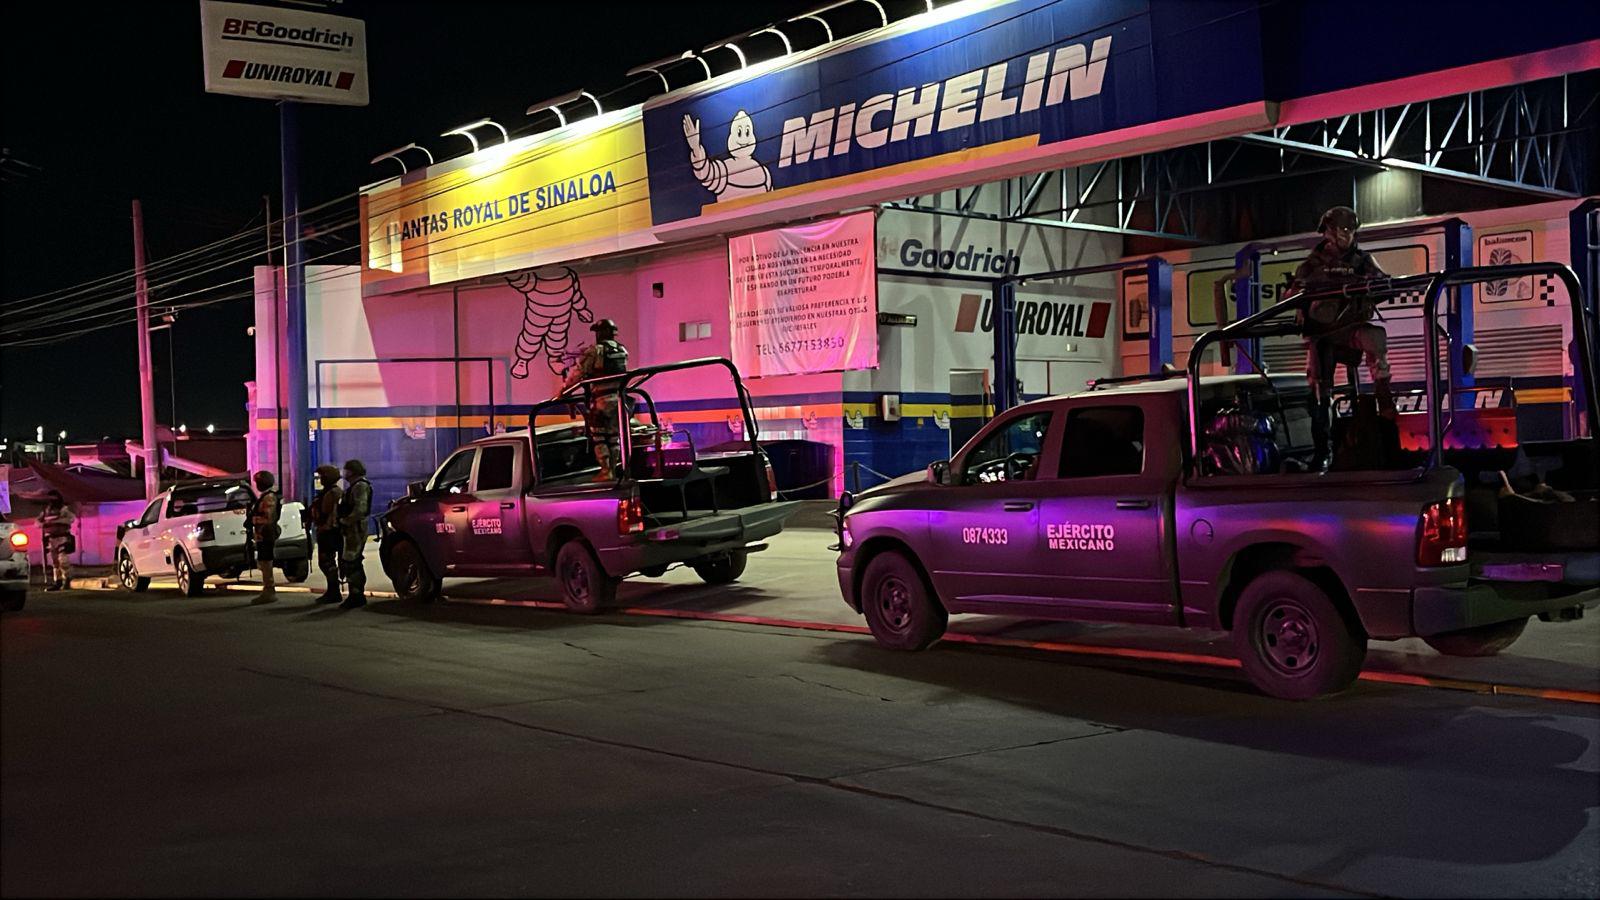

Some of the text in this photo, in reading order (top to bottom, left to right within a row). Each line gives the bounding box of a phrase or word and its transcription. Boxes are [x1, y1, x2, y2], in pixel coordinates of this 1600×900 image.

[222, 18, 353, 47] BFGoodrich
[245, 63, 333, 87] UNIROYAL
[778, 36, 1112, 168] MICHELIN
[453, 201, 503, 229] ROYAL
[508, 191, 530, 216] DE
[536, 170, 617, 210] SINALOA
[831, 238, 859, 249] NUESTRA
[767, 260, 778, 268] NOS
[818, 250, 851, 261] NECESIDAD
[798, 274, 821, 284] FUTURO
[822, 270, 850, 280] PODERLA
[810, 298, 850, 310] PREFERENCIA
[807, 312, 815, 320] EN
[816, 309, 847, 319] NUESTRAS
[962, 527, 1008, 545] 0874333
[1047, 521, 1115, 540] EJÉRCITO
[1049, 538, 1115, 551] MEXICANO
